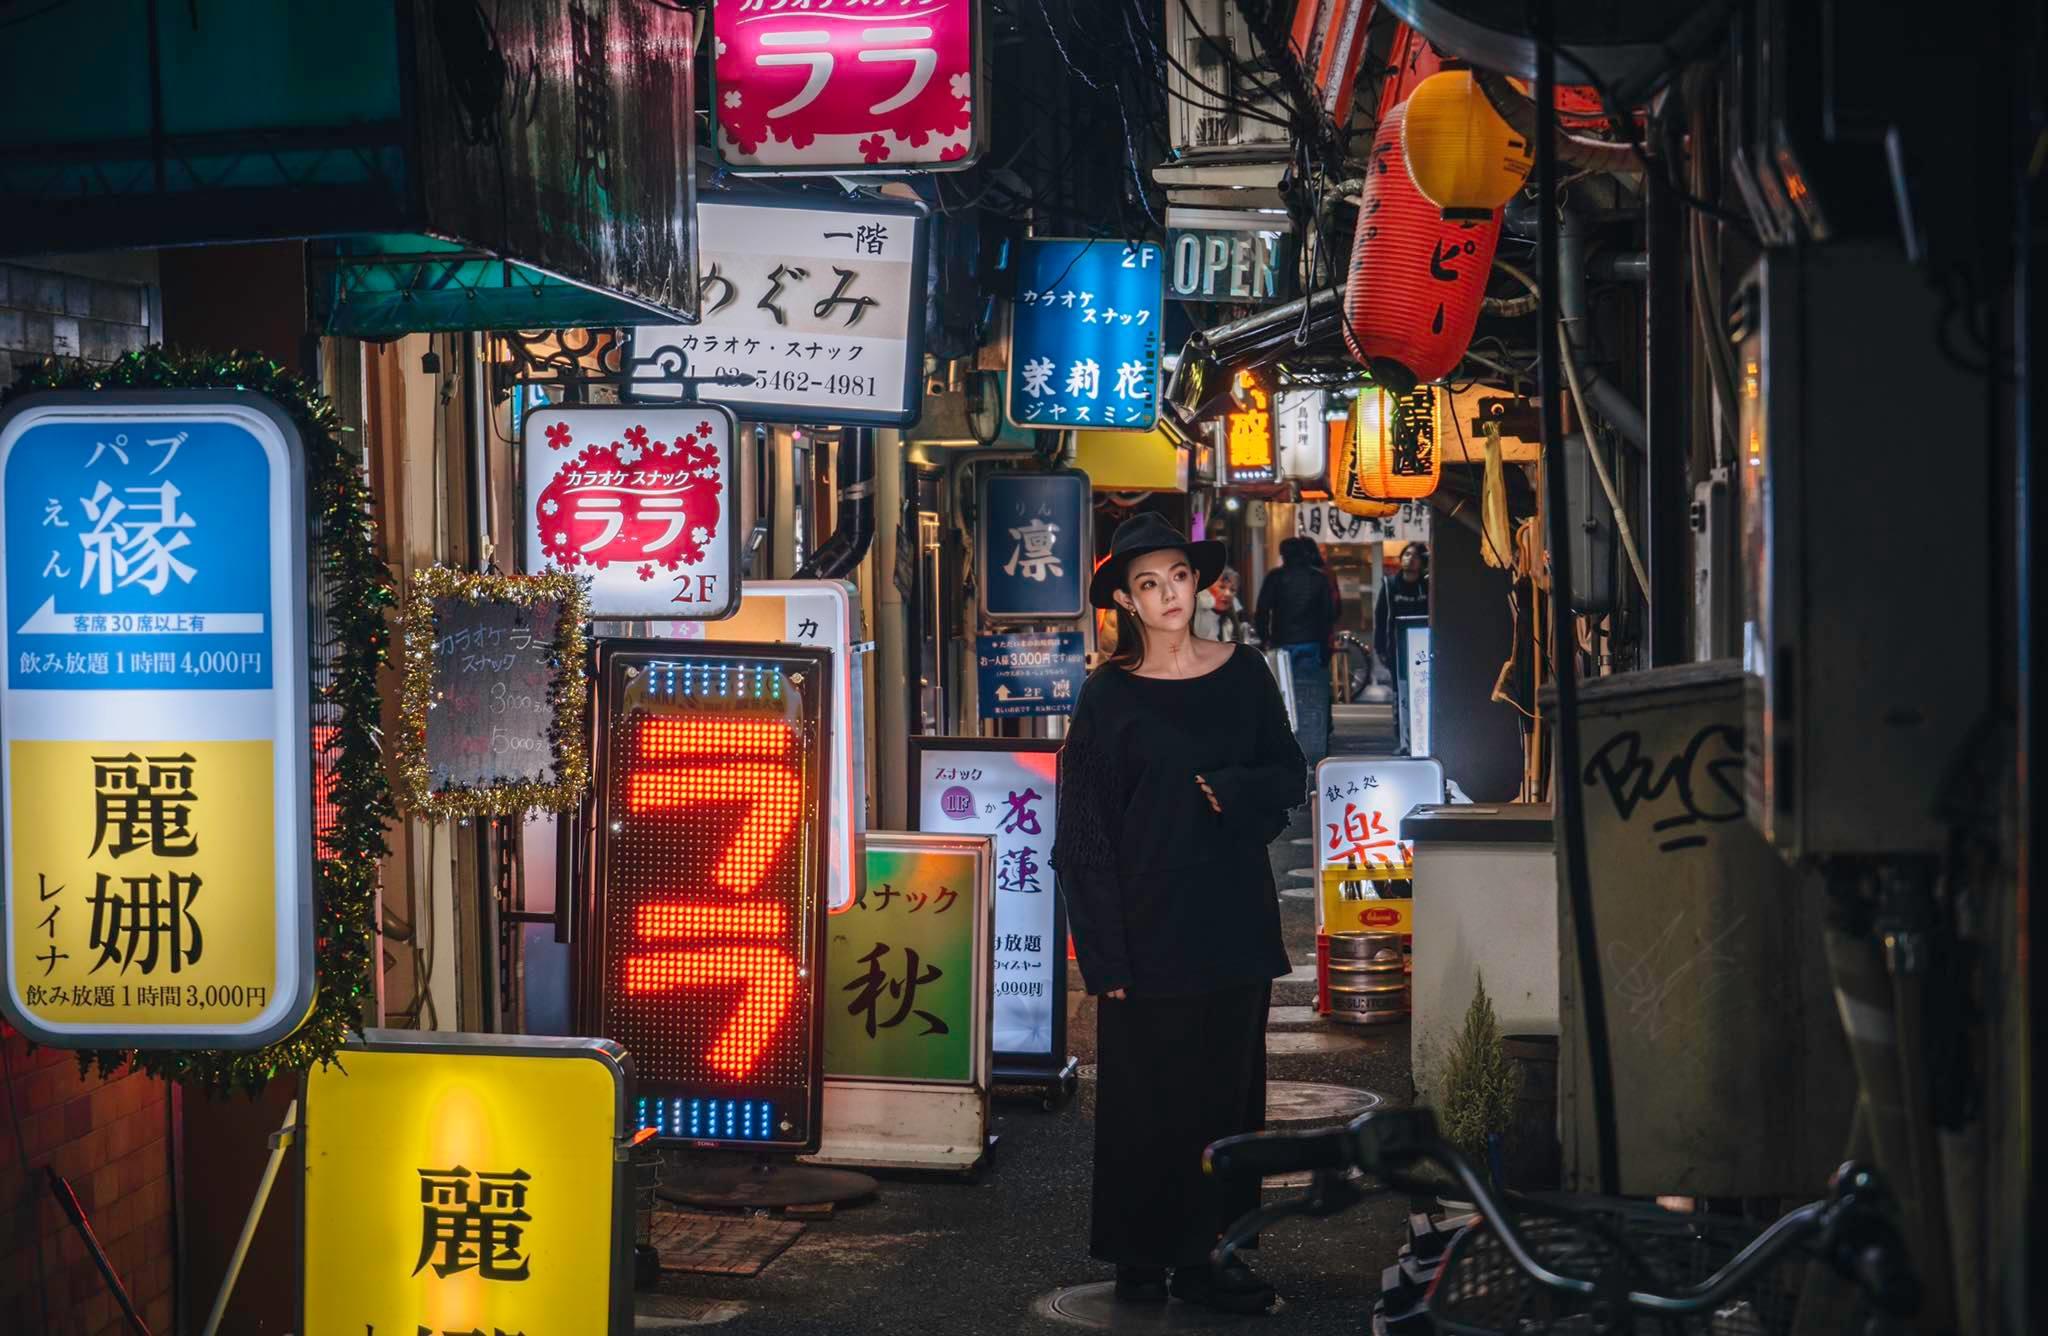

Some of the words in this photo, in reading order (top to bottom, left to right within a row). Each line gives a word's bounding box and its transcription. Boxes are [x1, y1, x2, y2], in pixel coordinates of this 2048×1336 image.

[755, 26, 938, 119] ララ
[823, 222, 889, 256] 一階
[1121, 248, 1154, 269] 2F
[1173, 232, 1281, 298] OPEN
[1023, 290, 1095, 309] カラオケ
[1082, 308, 1151, 326] スナック
[680, 334, 864, 361] カラオケ・スナック
[1021, 356, 1151, 400] 茉莉花
[84, 431, 189, 476] パブ
[566, 470, 629, 487] カラオケ
[630, 470, 690, 486] スナック
[573, 498, 686, 553] ララ
[1015, 501, 1052, 516] りん
[42, 498, 71, 578] えん
[79, 479, 198, 596] 縁
[671, 574, 718, 604] 2F
[73, 615, 206, 633] 客席30席以上有
[439, 623, 505, 656] カラオケ
[461, 654, 518, 673] スナック
[936, 767, 983, 780] スナック
[994, 787, 1043, 894] 花蓮
[1326, 802, 1397, 868] 楽
[85, 751, 204, 978] 麗娜
[626, 720, 801, 1079] ララ
[35, 872, 70, 977] レイナ
[841, 942, 949, 1039] 秋
[994, 980, 1043, 997] ,000円
